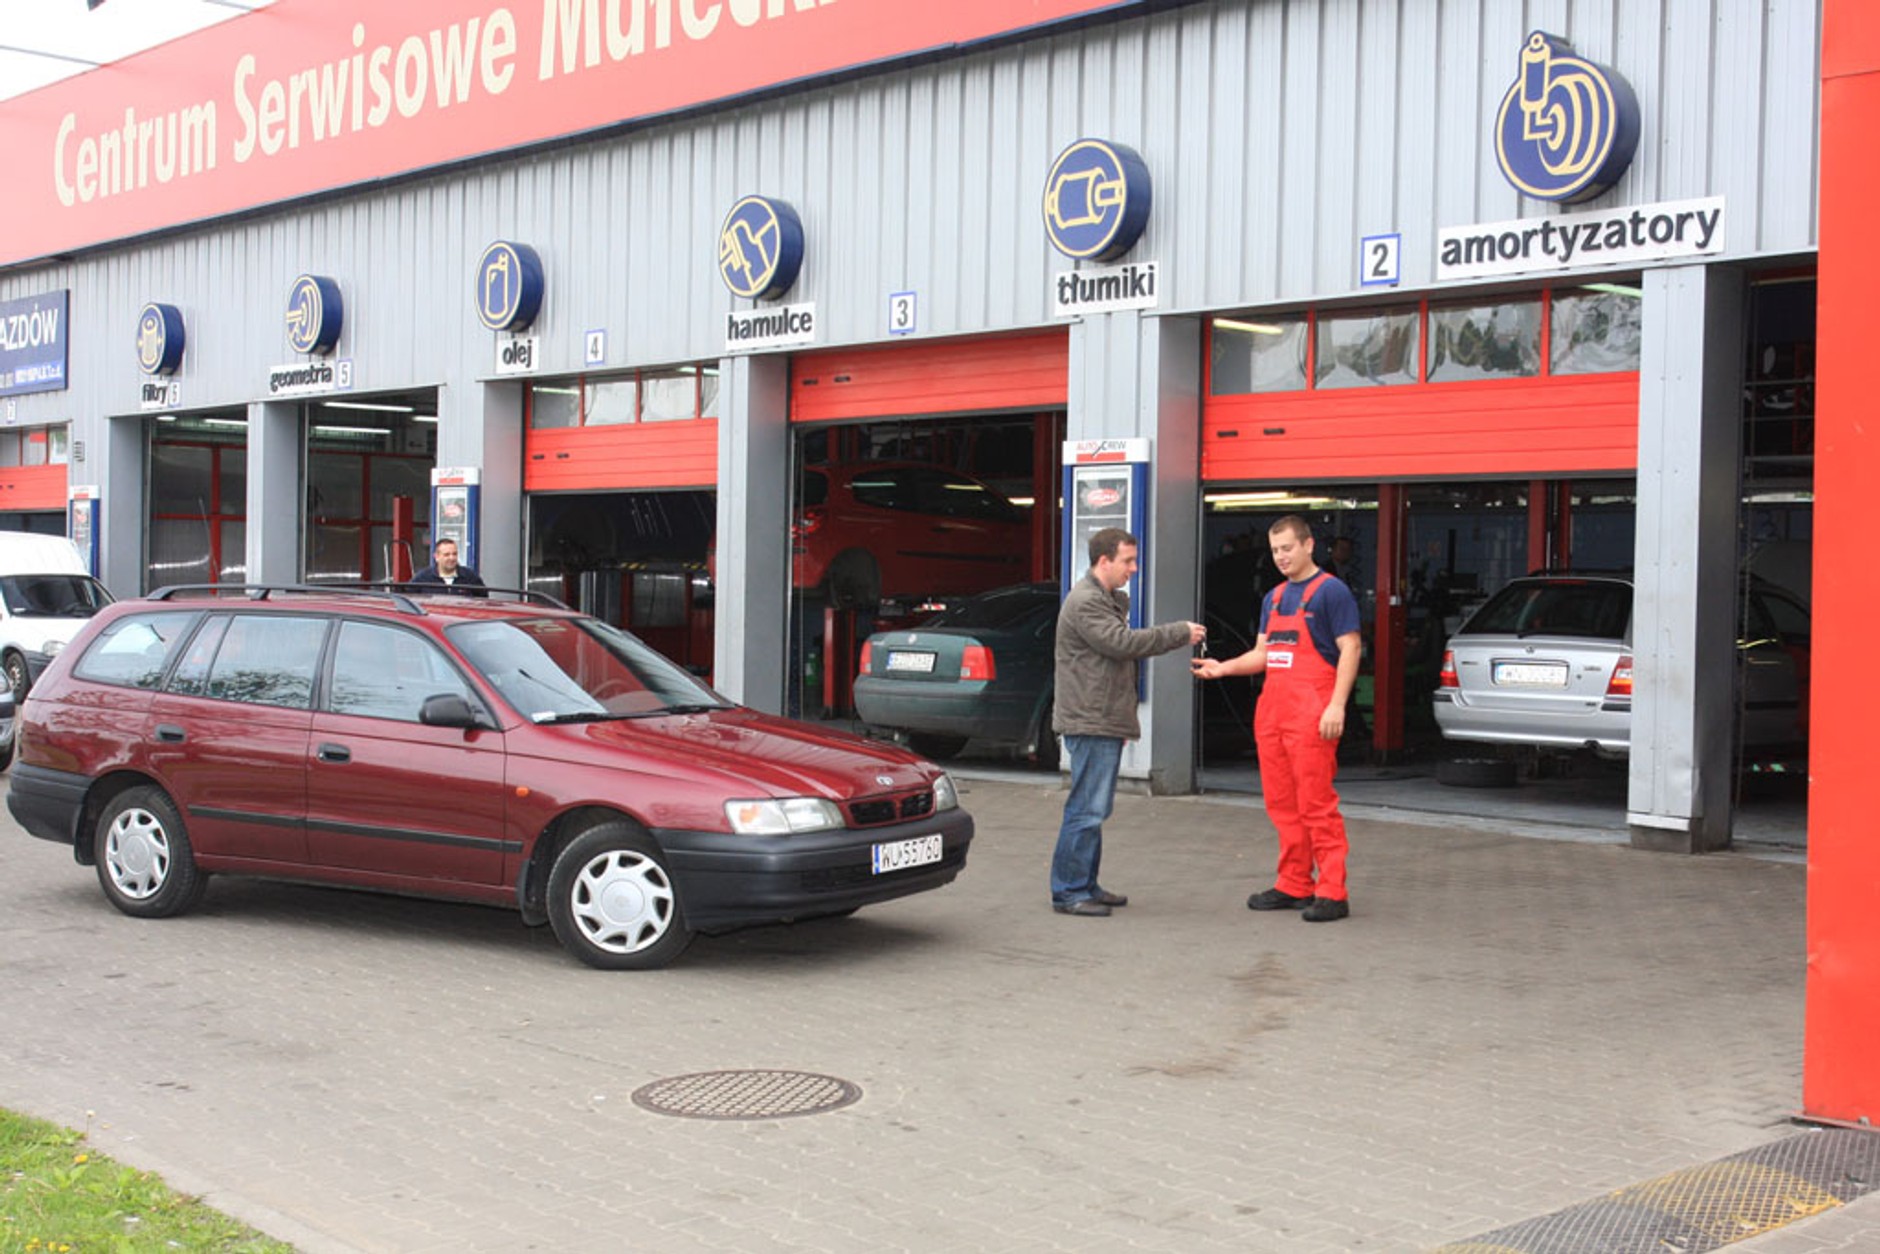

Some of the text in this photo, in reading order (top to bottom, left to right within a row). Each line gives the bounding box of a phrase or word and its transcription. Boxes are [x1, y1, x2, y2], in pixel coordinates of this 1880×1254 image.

[54, 97, 217, 207] Centrum
[233, 7, 518, 163] Serwisowe
[1440, 207, 1721, 264] amortyzatory
[1371, 242, 1389, 277] 2
[1057, 263, 1155, 305] tłumiki
[727, 307, 813, 341] hamulce
[896, 298, 909, 327] 3
[502, 339, 533, 369] olej
[590, 335, 600, 359] 4
[270, 362, 333, 393] geometria
[341, 363, 349, 384] 5
[142, 383, 169, 405] filtry
